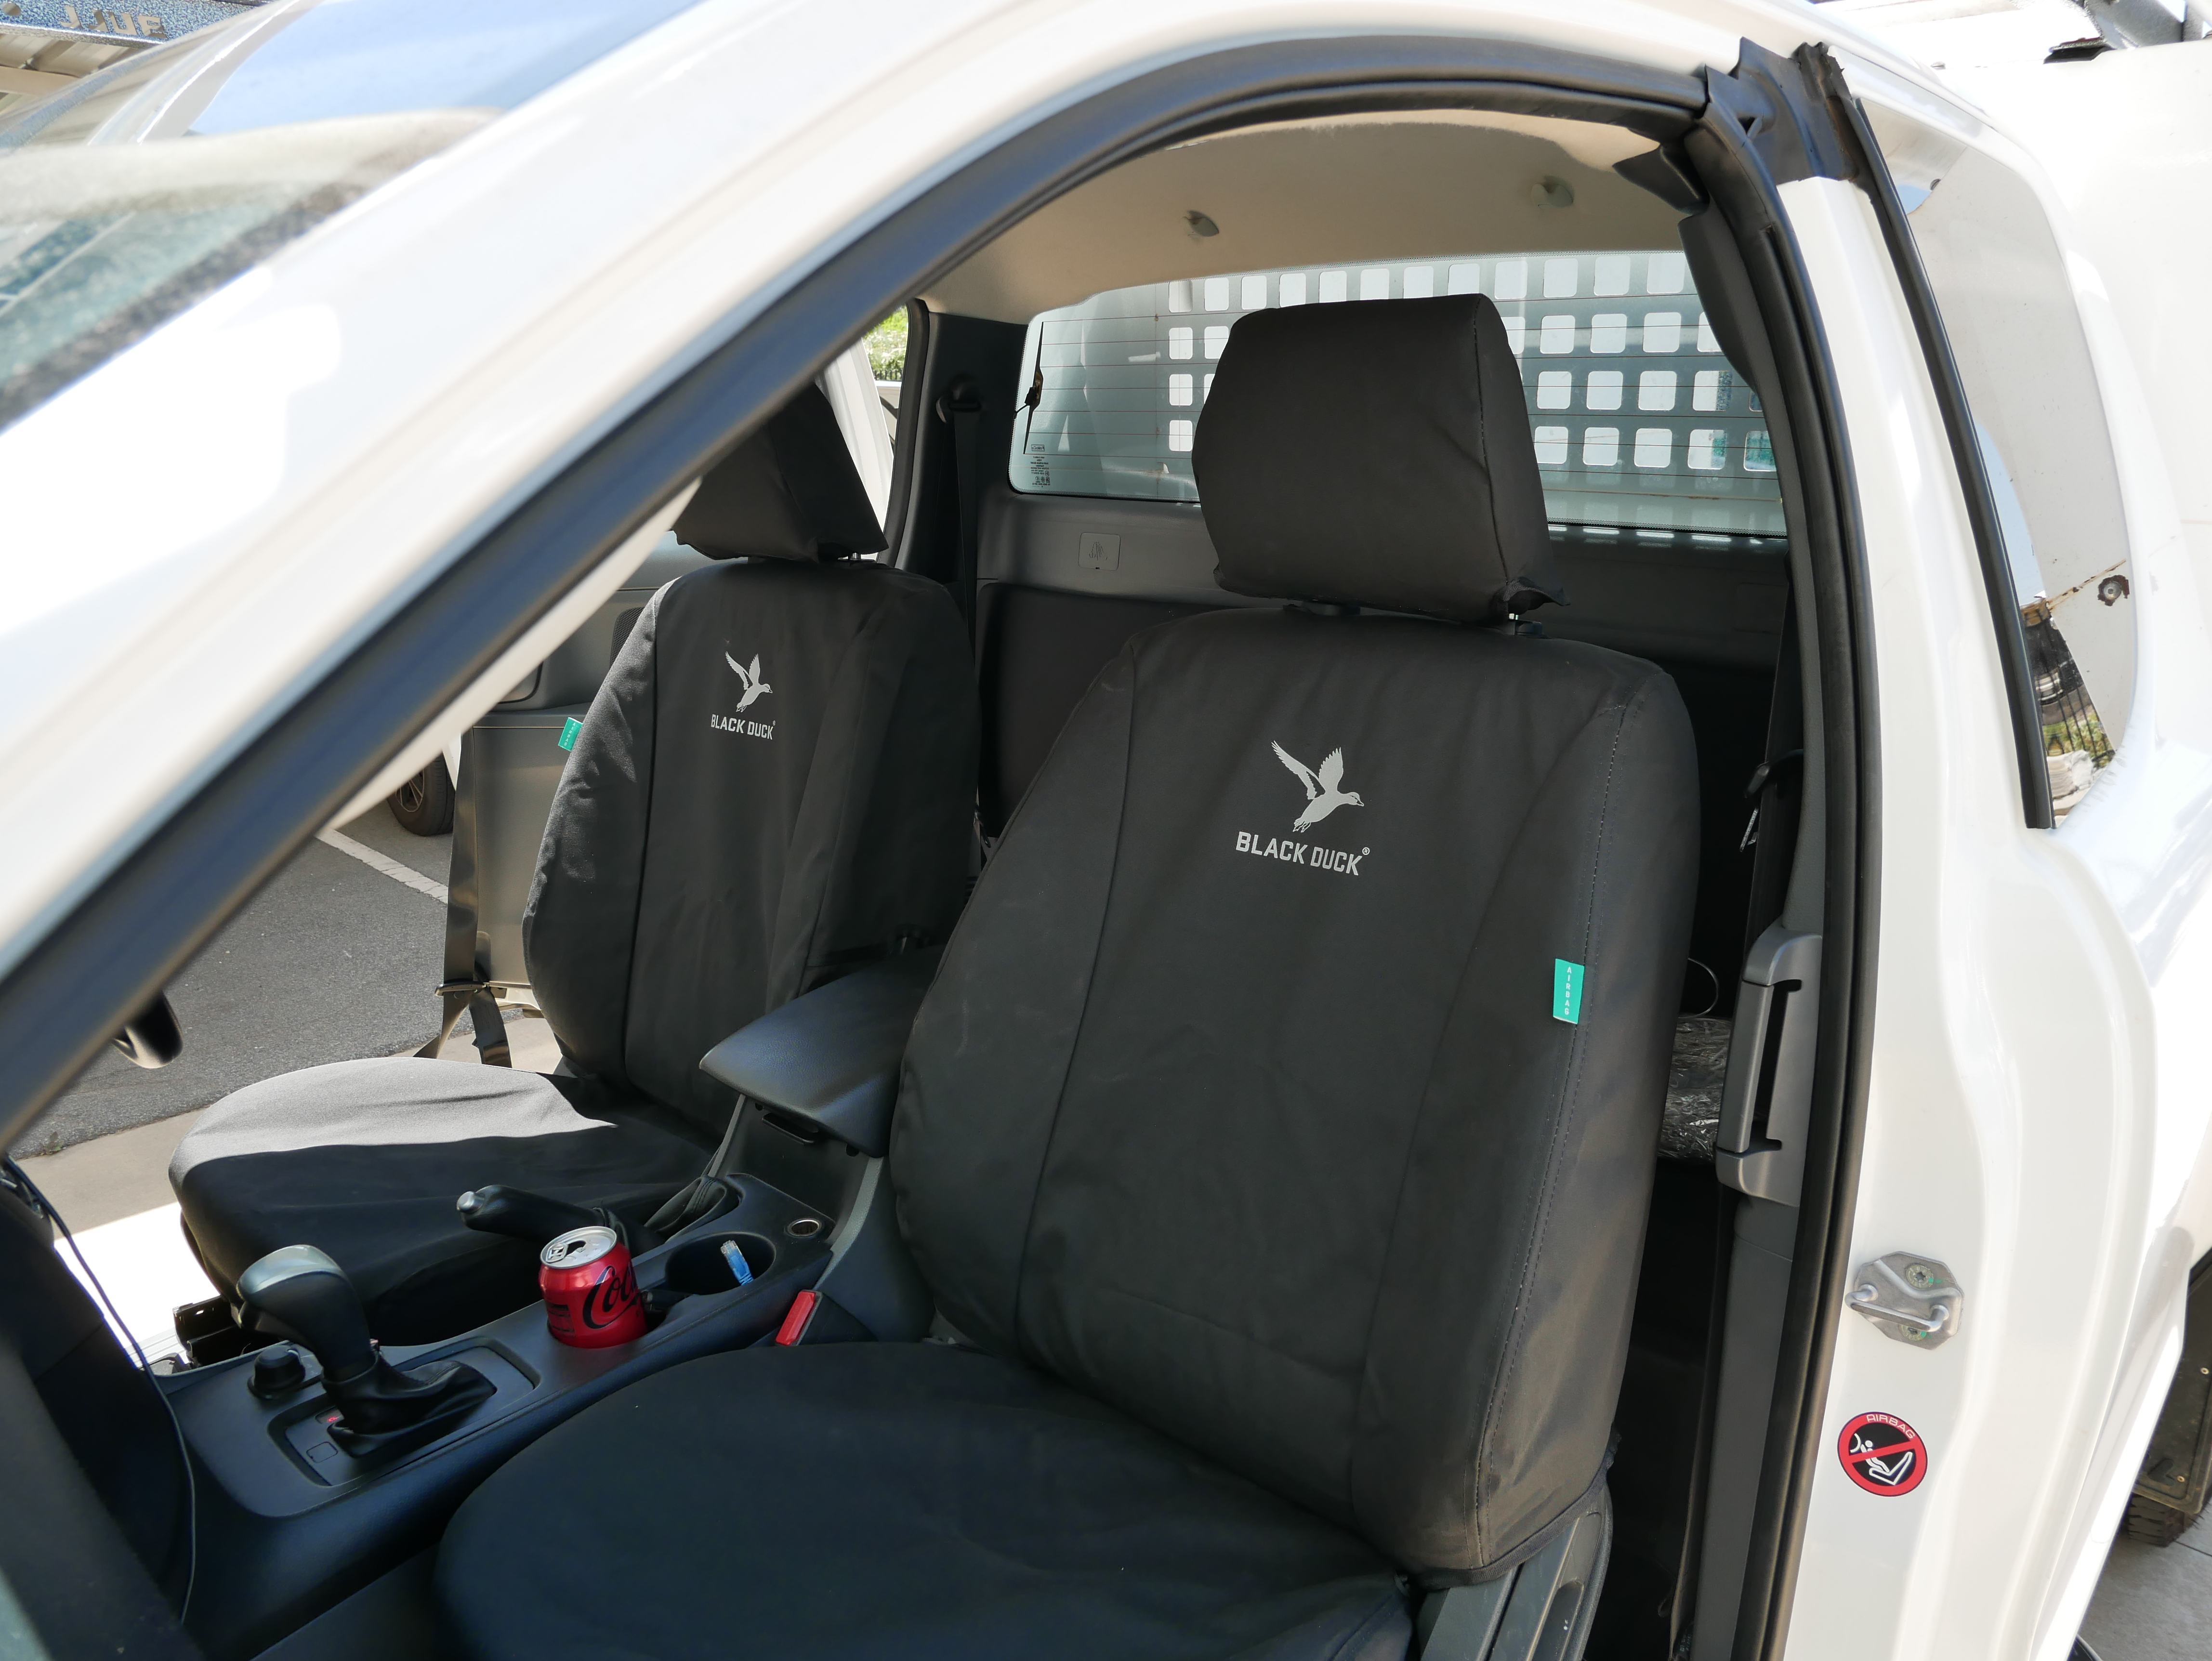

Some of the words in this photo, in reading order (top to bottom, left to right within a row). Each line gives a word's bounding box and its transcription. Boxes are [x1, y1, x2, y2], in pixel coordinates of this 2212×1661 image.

[711, 714, 746, 734] BLACK
[1236, 831, 1308, 864] BLACK
[1866, 1414, 1915, 1439] AIRBAG
